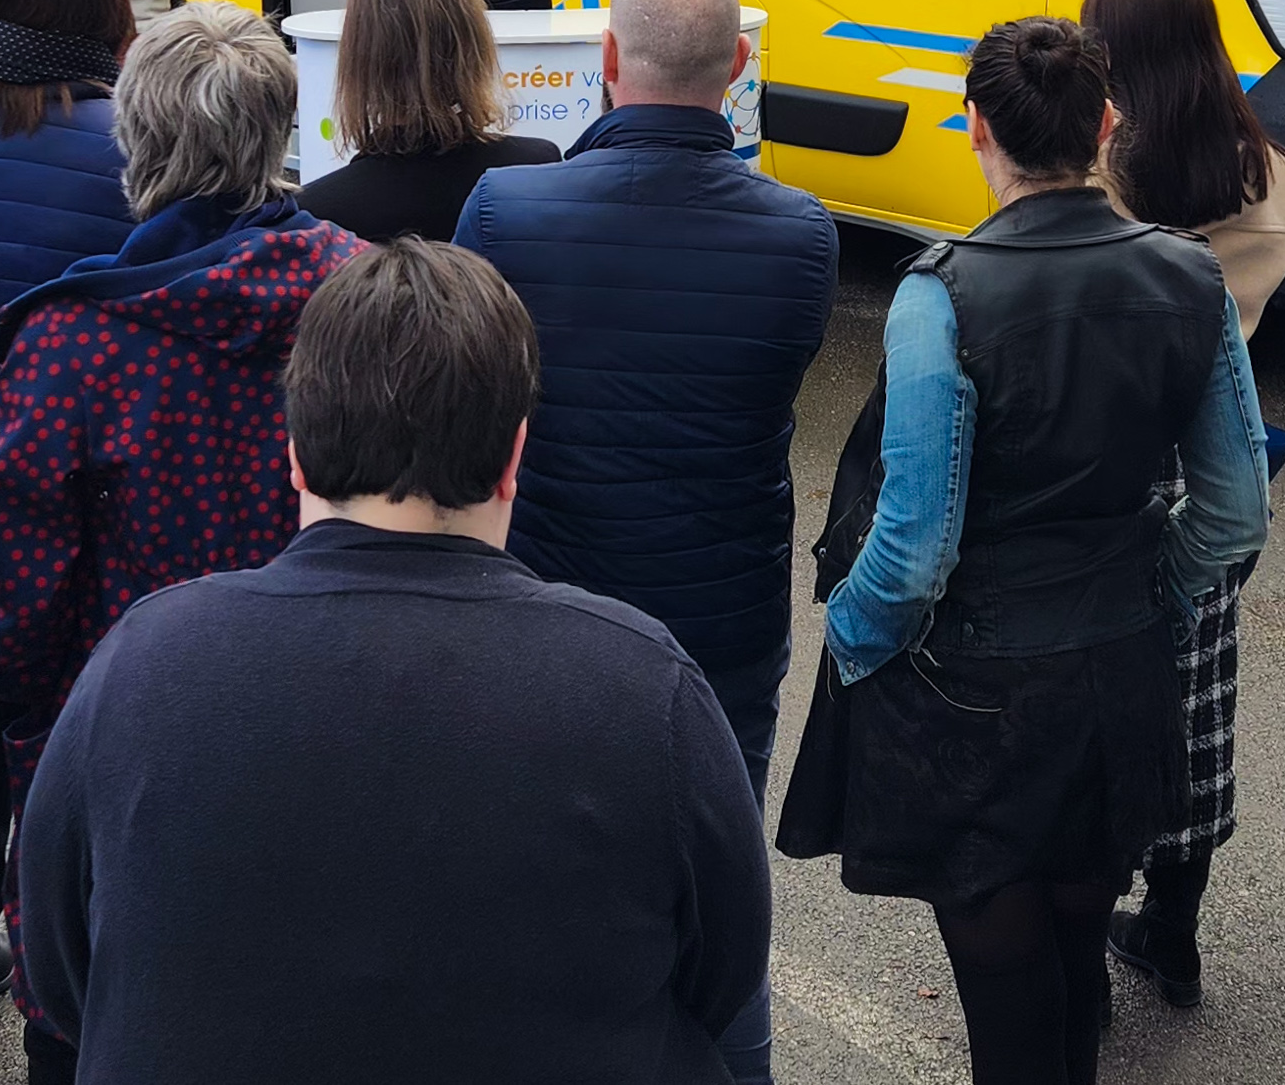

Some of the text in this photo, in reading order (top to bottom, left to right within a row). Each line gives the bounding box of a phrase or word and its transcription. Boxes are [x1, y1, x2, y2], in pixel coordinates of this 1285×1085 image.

[502, 64, 575, 88] créer
[508, 98, 590, 121] prise ?
